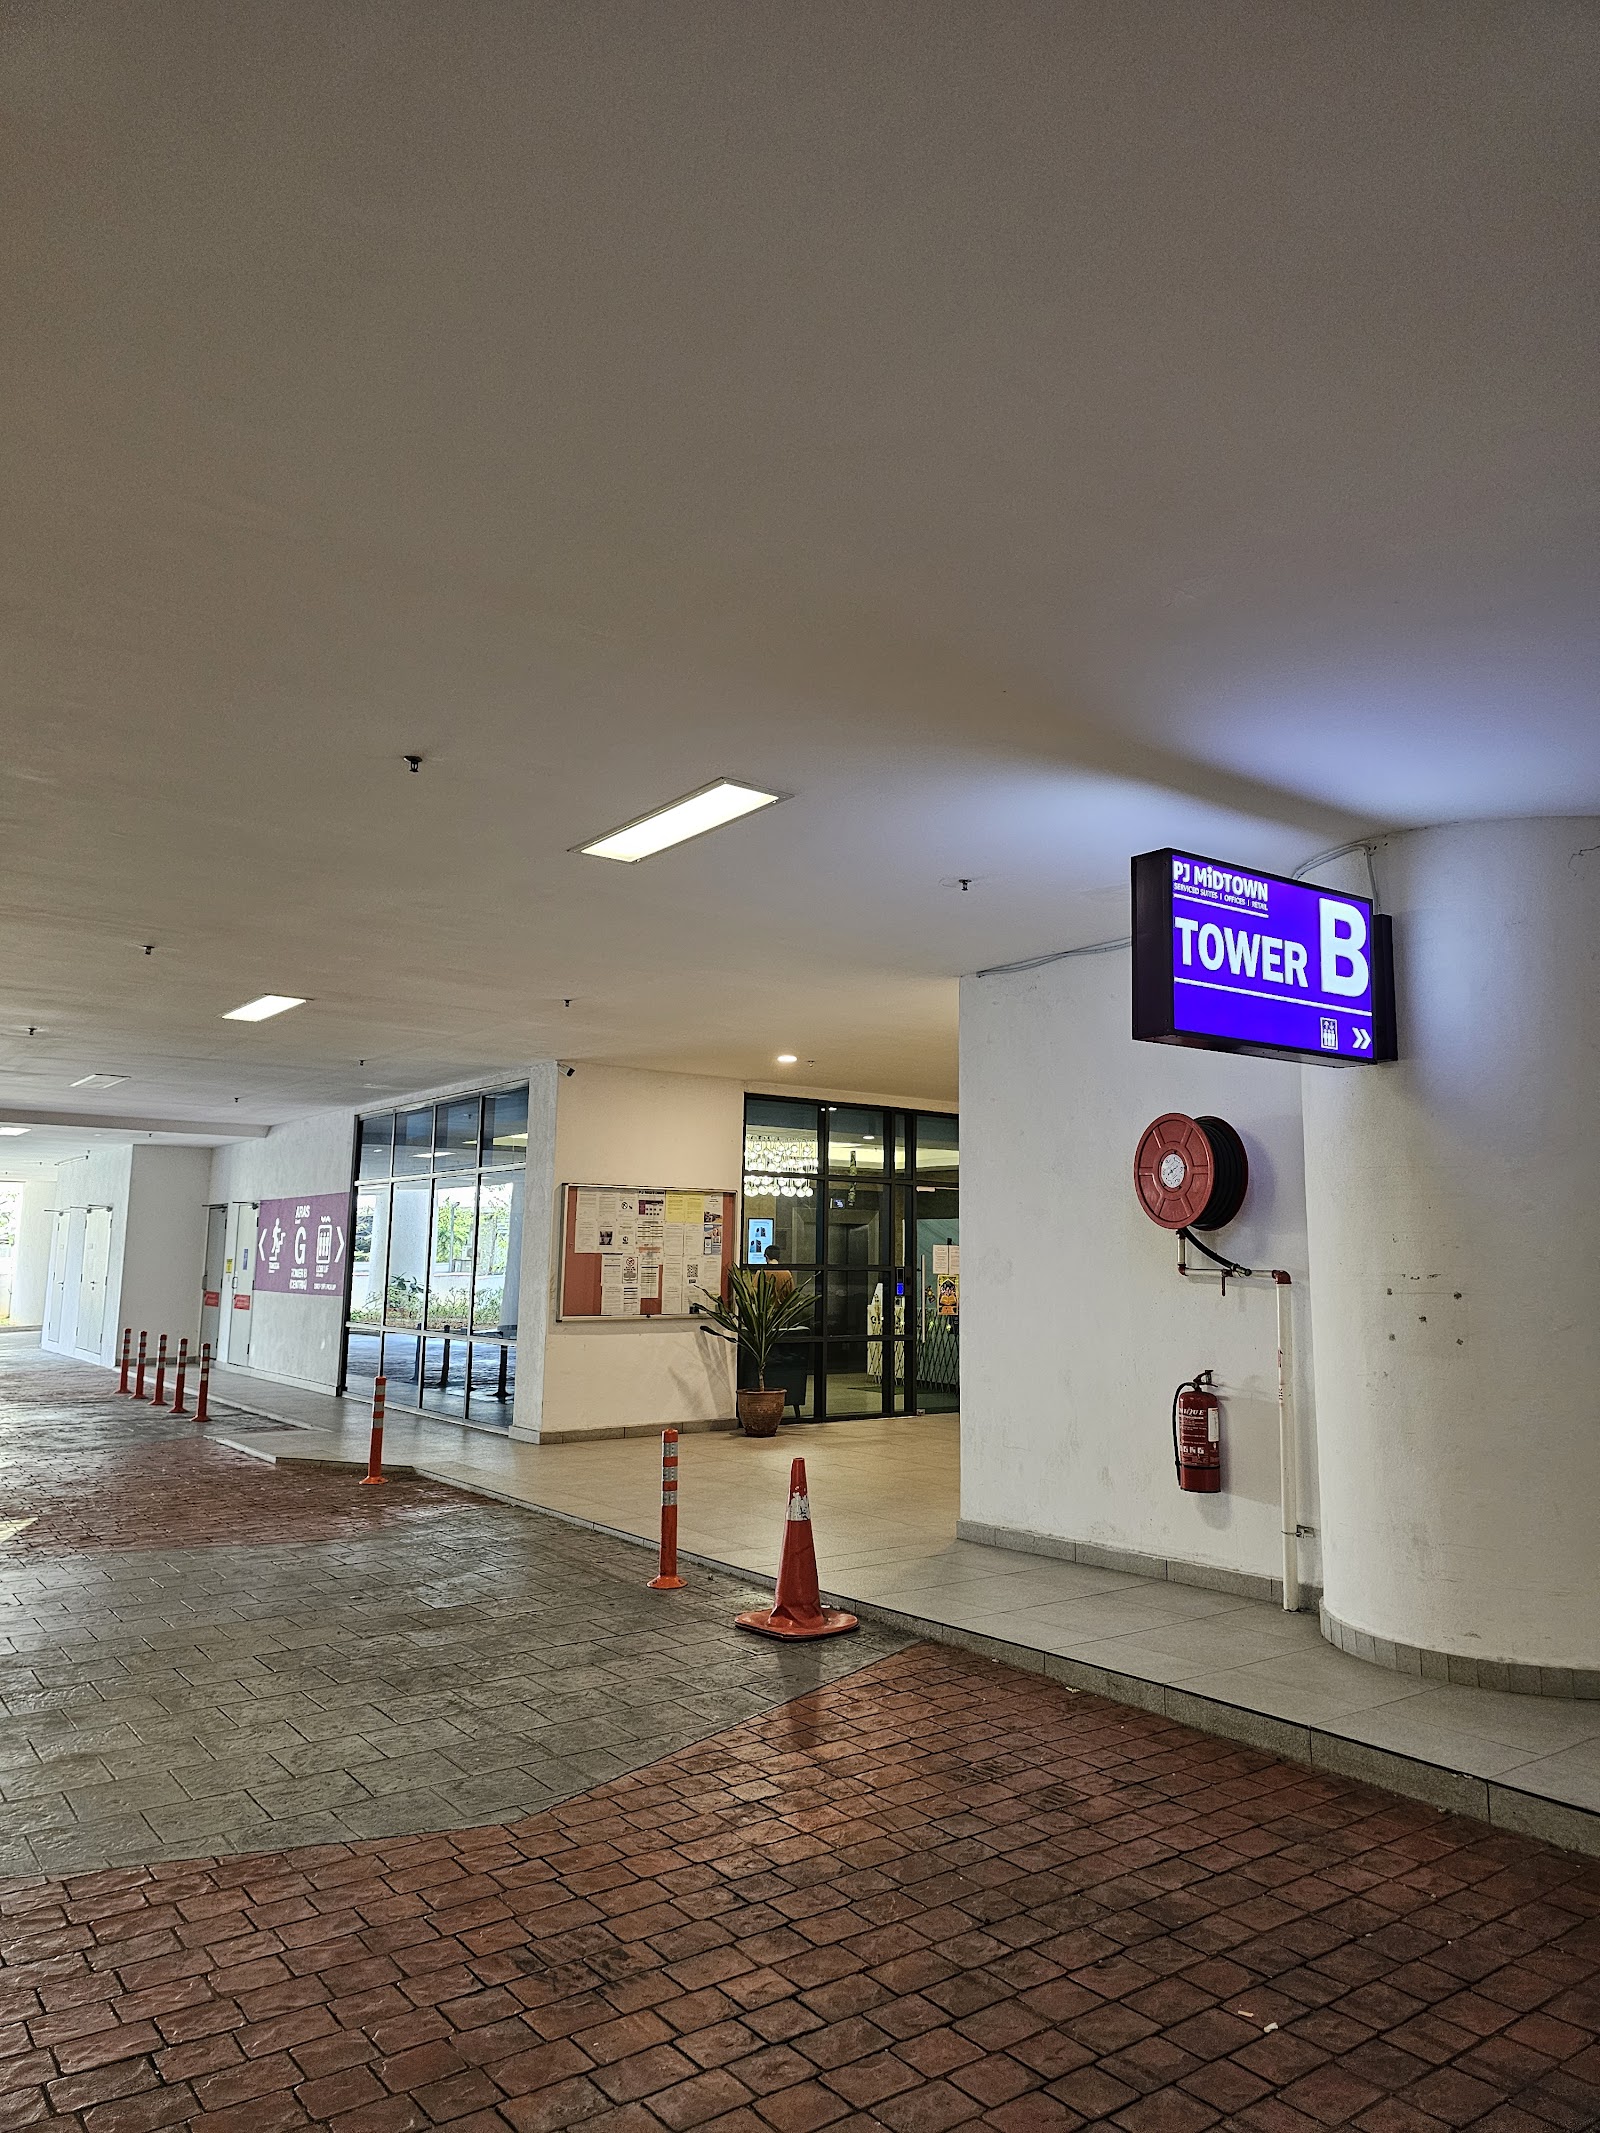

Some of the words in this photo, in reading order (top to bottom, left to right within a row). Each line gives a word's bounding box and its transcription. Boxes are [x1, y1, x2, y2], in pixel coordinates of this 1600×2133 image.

[1173, 860, 1190, 882] PJ
[1173, 882, 1199, 895] SERVICED
[1200, 889, 1218, 899] SUITES
[1224, 895, 1245, 905] OFFICES
[1252, 901, 1268, 911] RETAIL
[1174, 916, 1308, 988] TOWER
[1319, 897, 1369, 998] B
[295, 1226, 306, 1264] G
